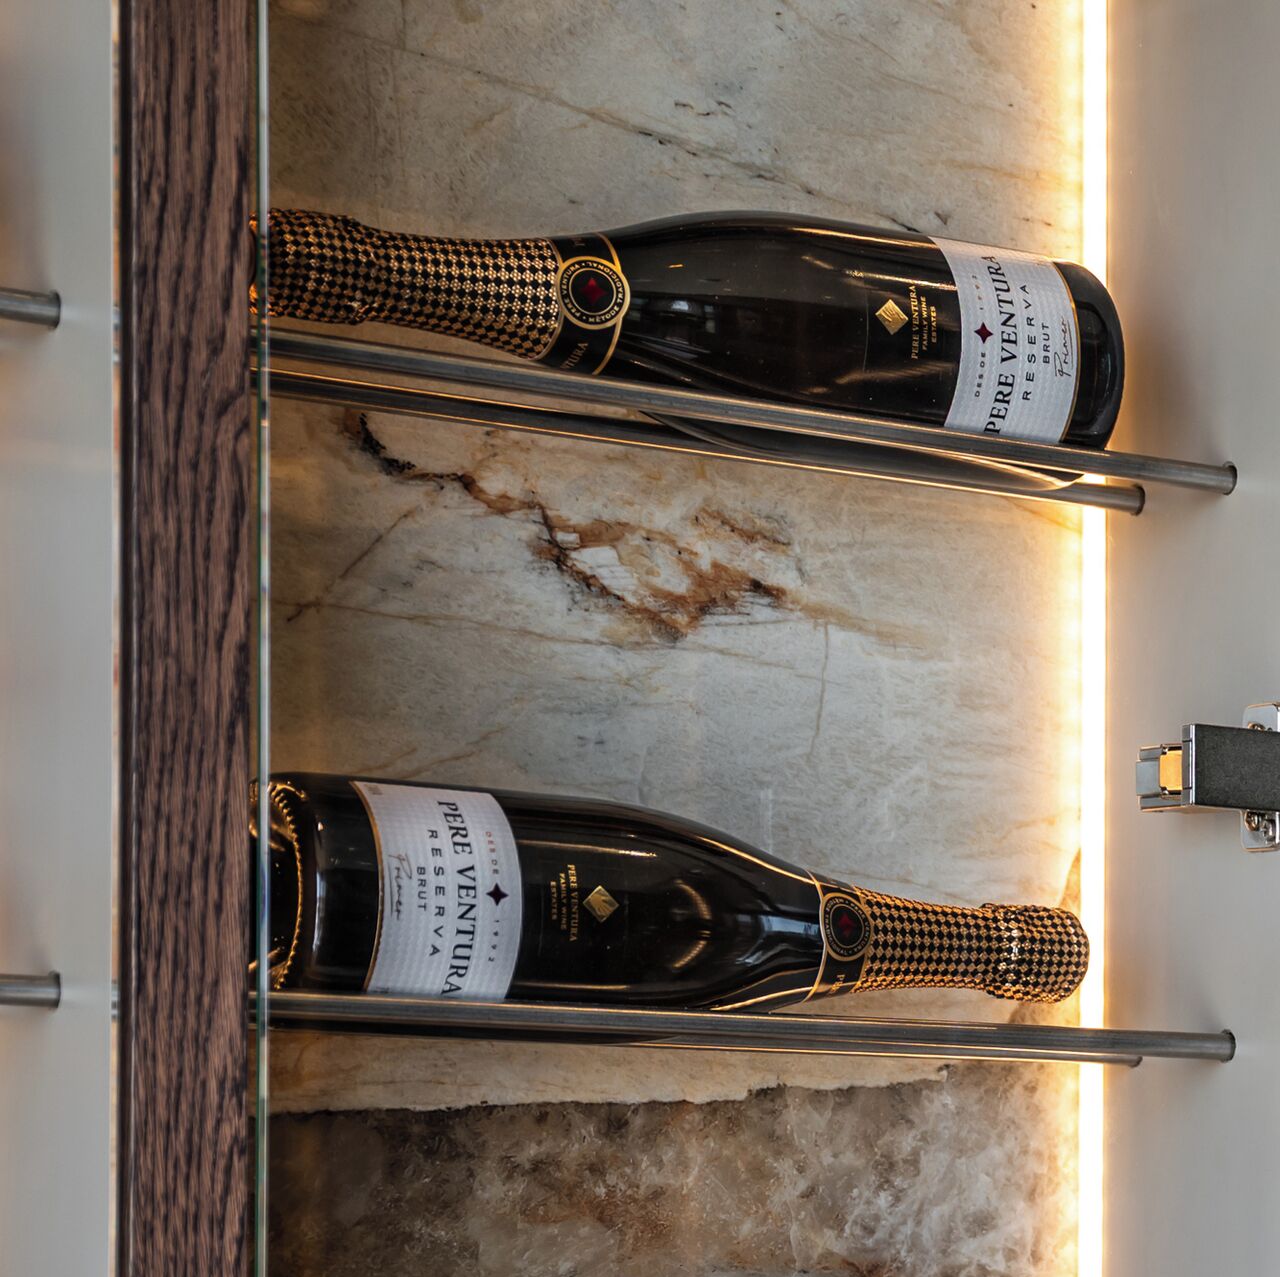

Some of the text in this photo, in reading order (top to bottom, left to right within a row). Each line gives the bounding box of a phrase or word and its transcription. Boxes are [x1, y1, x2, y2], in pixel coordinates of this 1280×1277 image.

[909, 285, 919, 331] VENTURA
[981, 255, 1018, 434] PERE VENTURA
[1020, 285, 1036, 400] RESERVA
[416, 867, 427, 911] BRUT
[427, 829, 446, 956] RESERVA
[437, 801, 477, 996] PERE VENTURA
